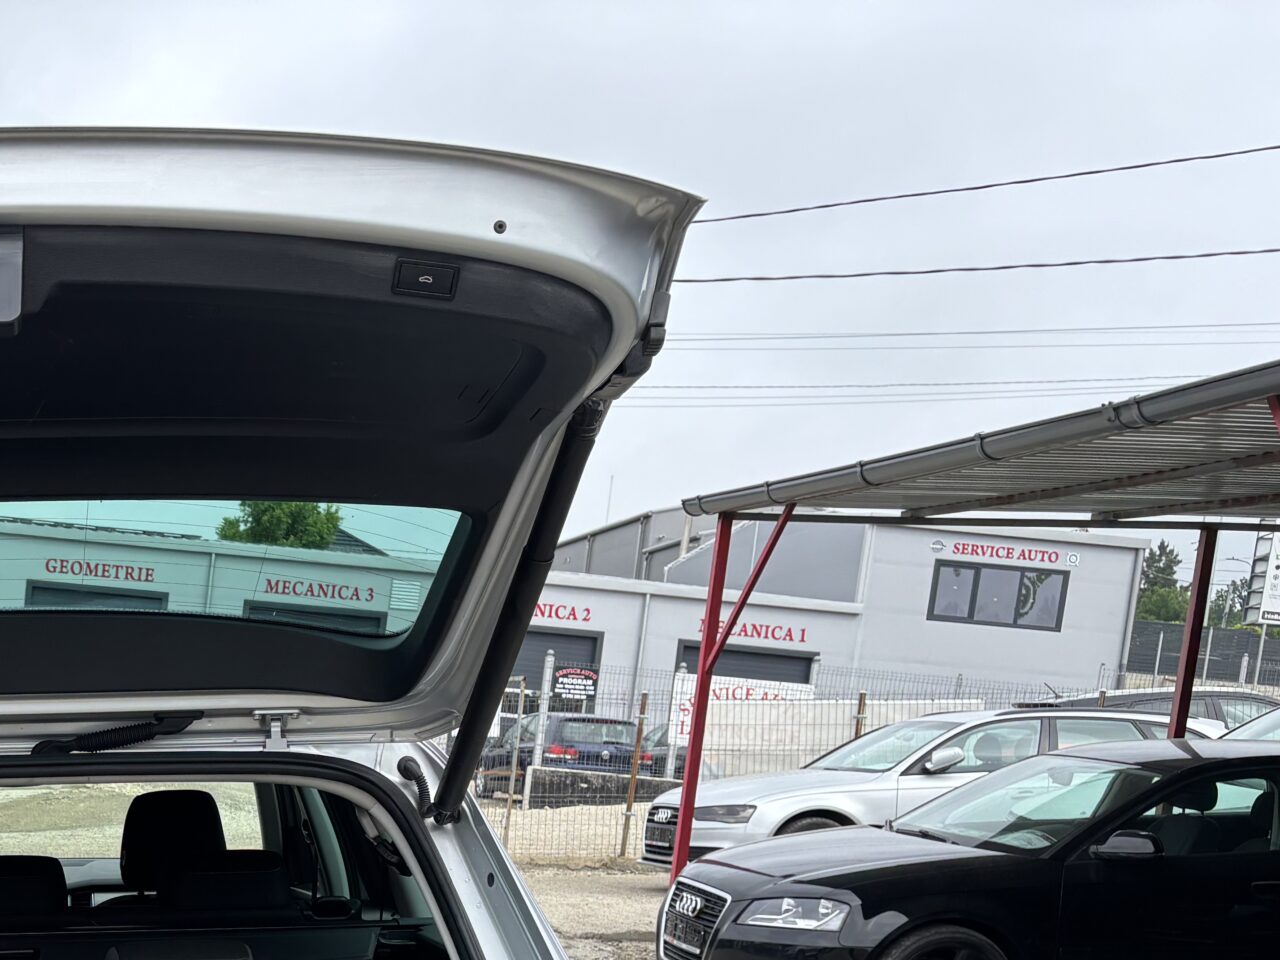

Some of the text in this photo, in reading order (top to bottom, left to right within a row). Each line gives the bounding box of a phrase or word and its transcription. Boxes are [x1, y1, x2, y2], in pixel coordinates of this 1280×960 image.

[952, 542, 1059, 563] SERVICE AUTO
[45, 558, 155, 582] GEOMETRIE
[264, 578, 375, 602] MECANICA 3
[534, 603, 591, 622] NICA 2
[799, 628, 807, 643] 1
[558, 677, 593, 686] PROGRAM
